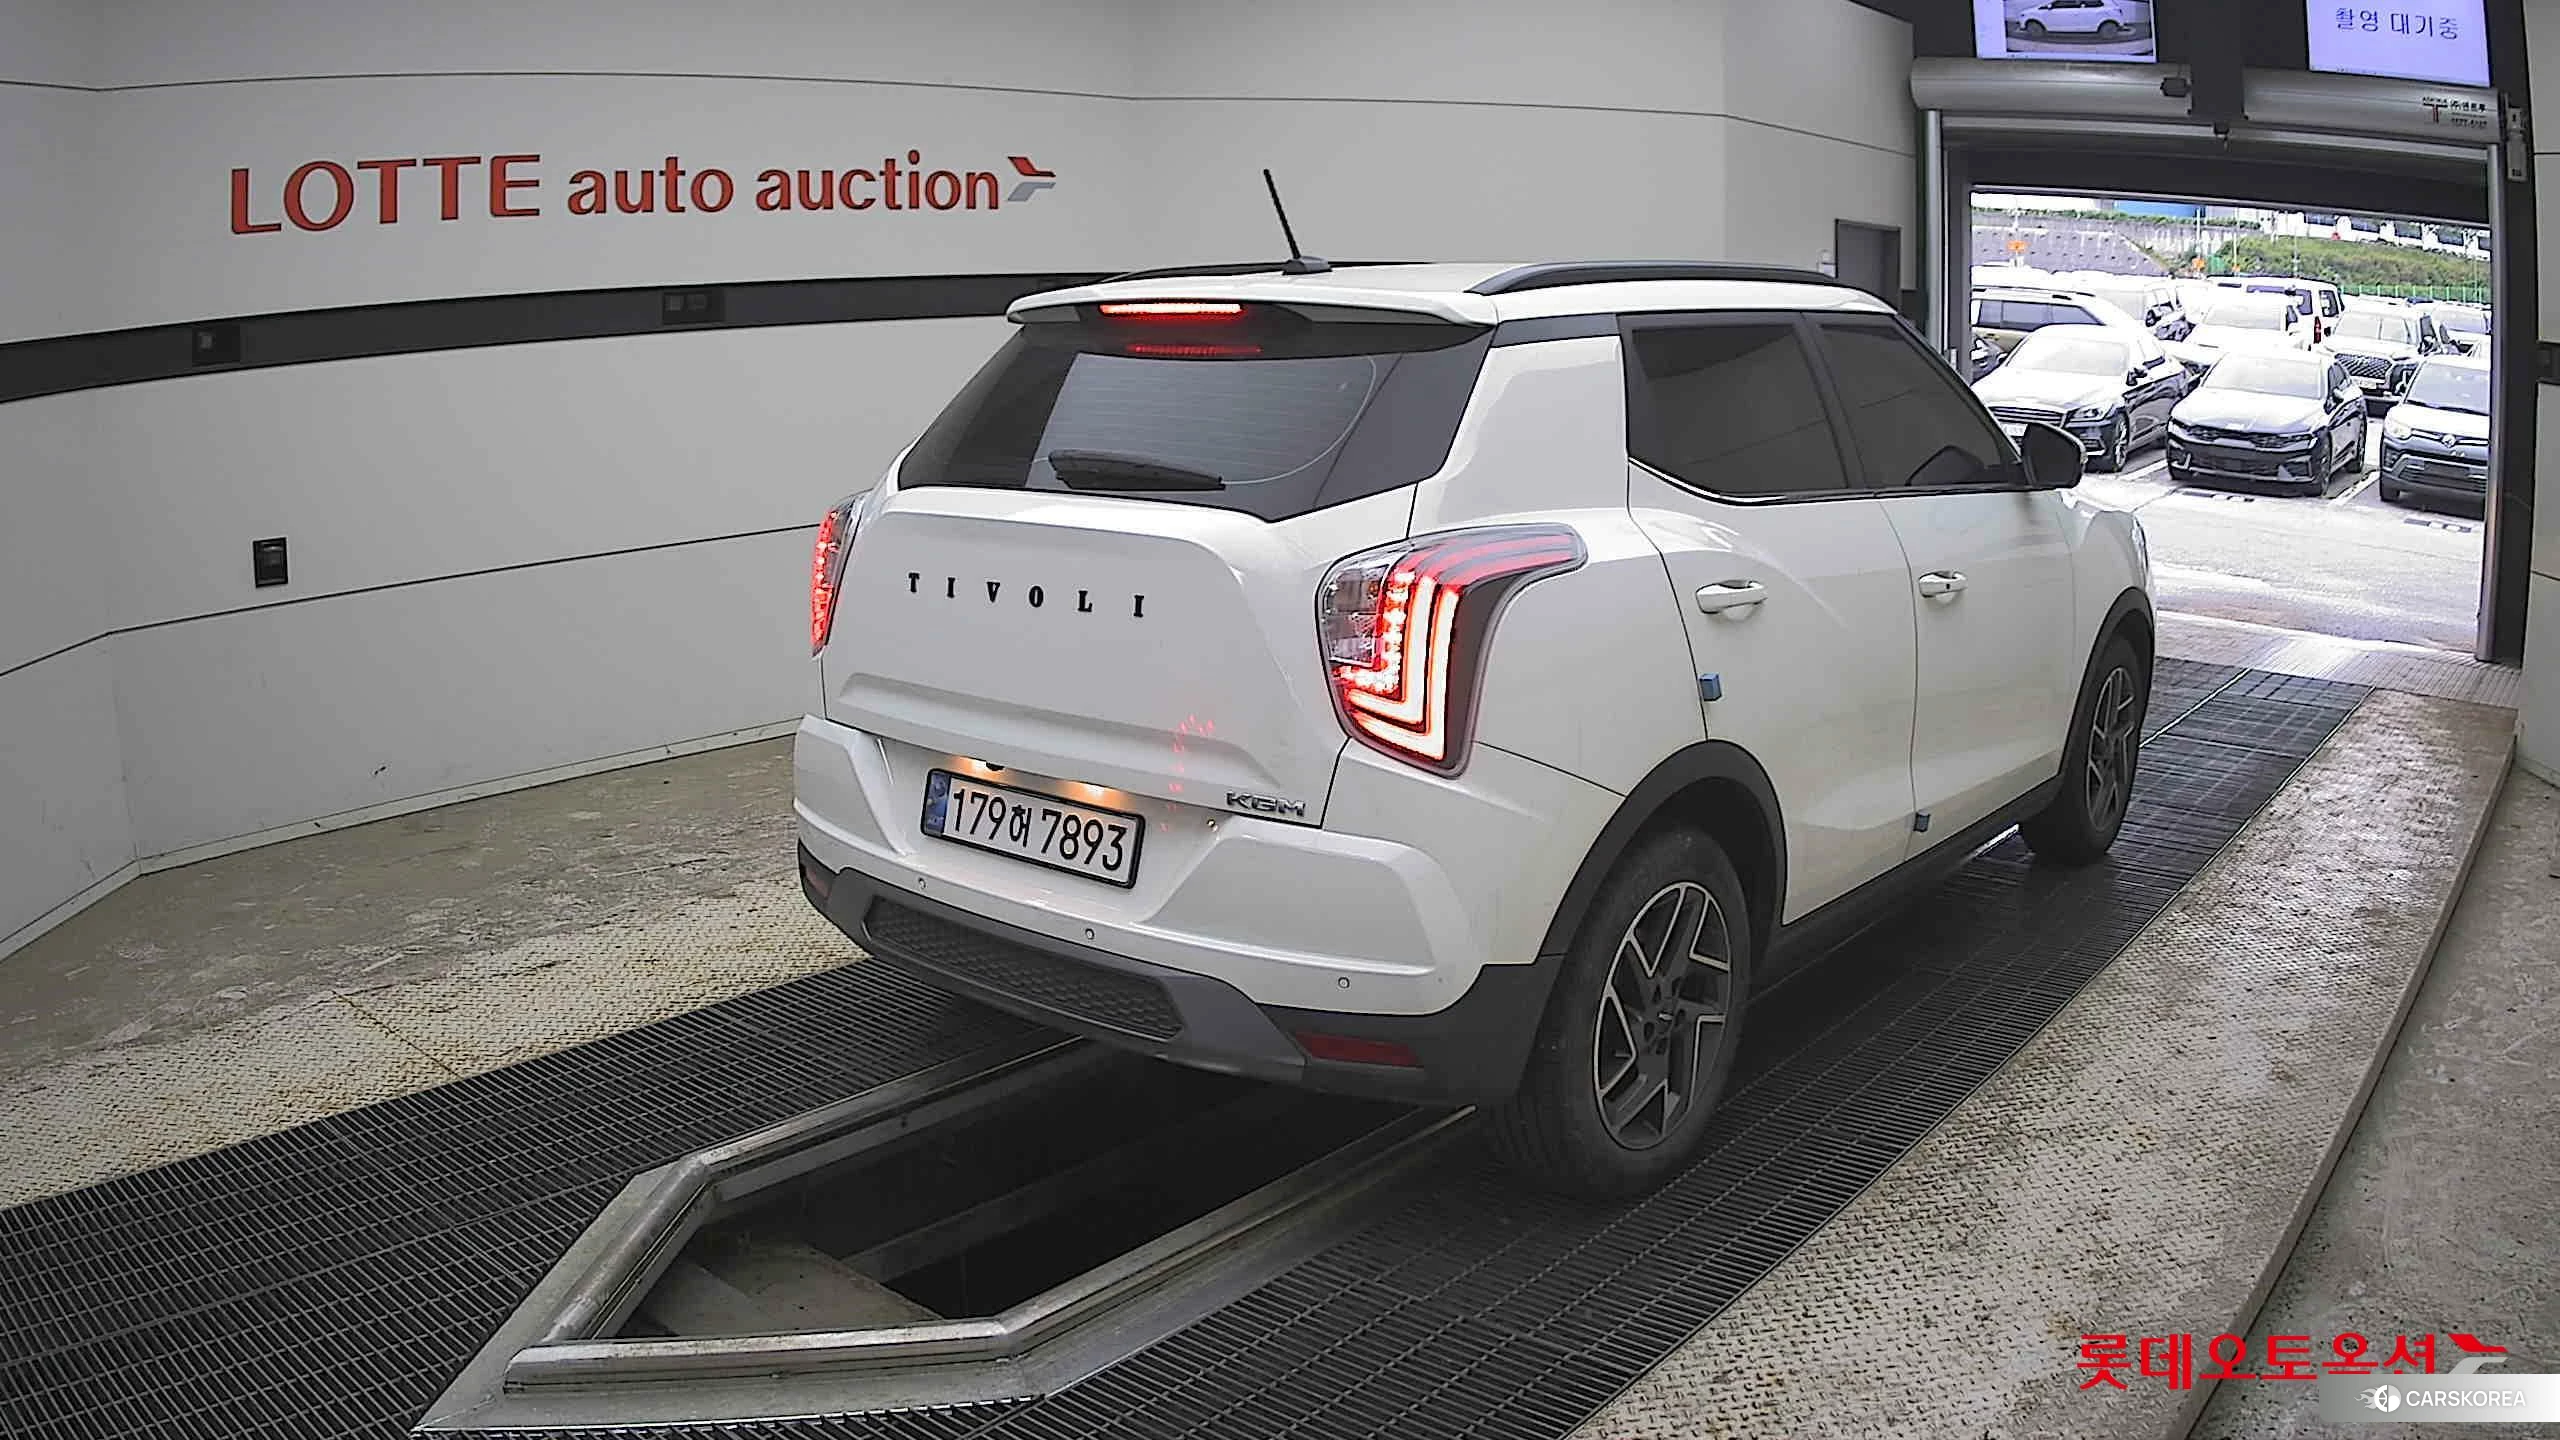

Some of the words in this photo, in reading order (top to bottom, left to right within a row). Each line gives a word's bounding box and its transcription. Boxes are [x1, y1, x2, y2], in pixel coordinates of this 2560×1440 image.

[2335, 7, 2379, 32] 촬영
[2390, 12, 2459, 40] 대기중
[231, 154, 541, 235] LOTTE
[567, 156, 734, 214] auto
[755, 149, 999, 212] auction
[908, 572, 1145, 618] TIVOLI
[1225, 791, 1306, 817] KGM
[953, 788, 1032, 848] 179허
[1041, 808, 1128, 871] 7893
